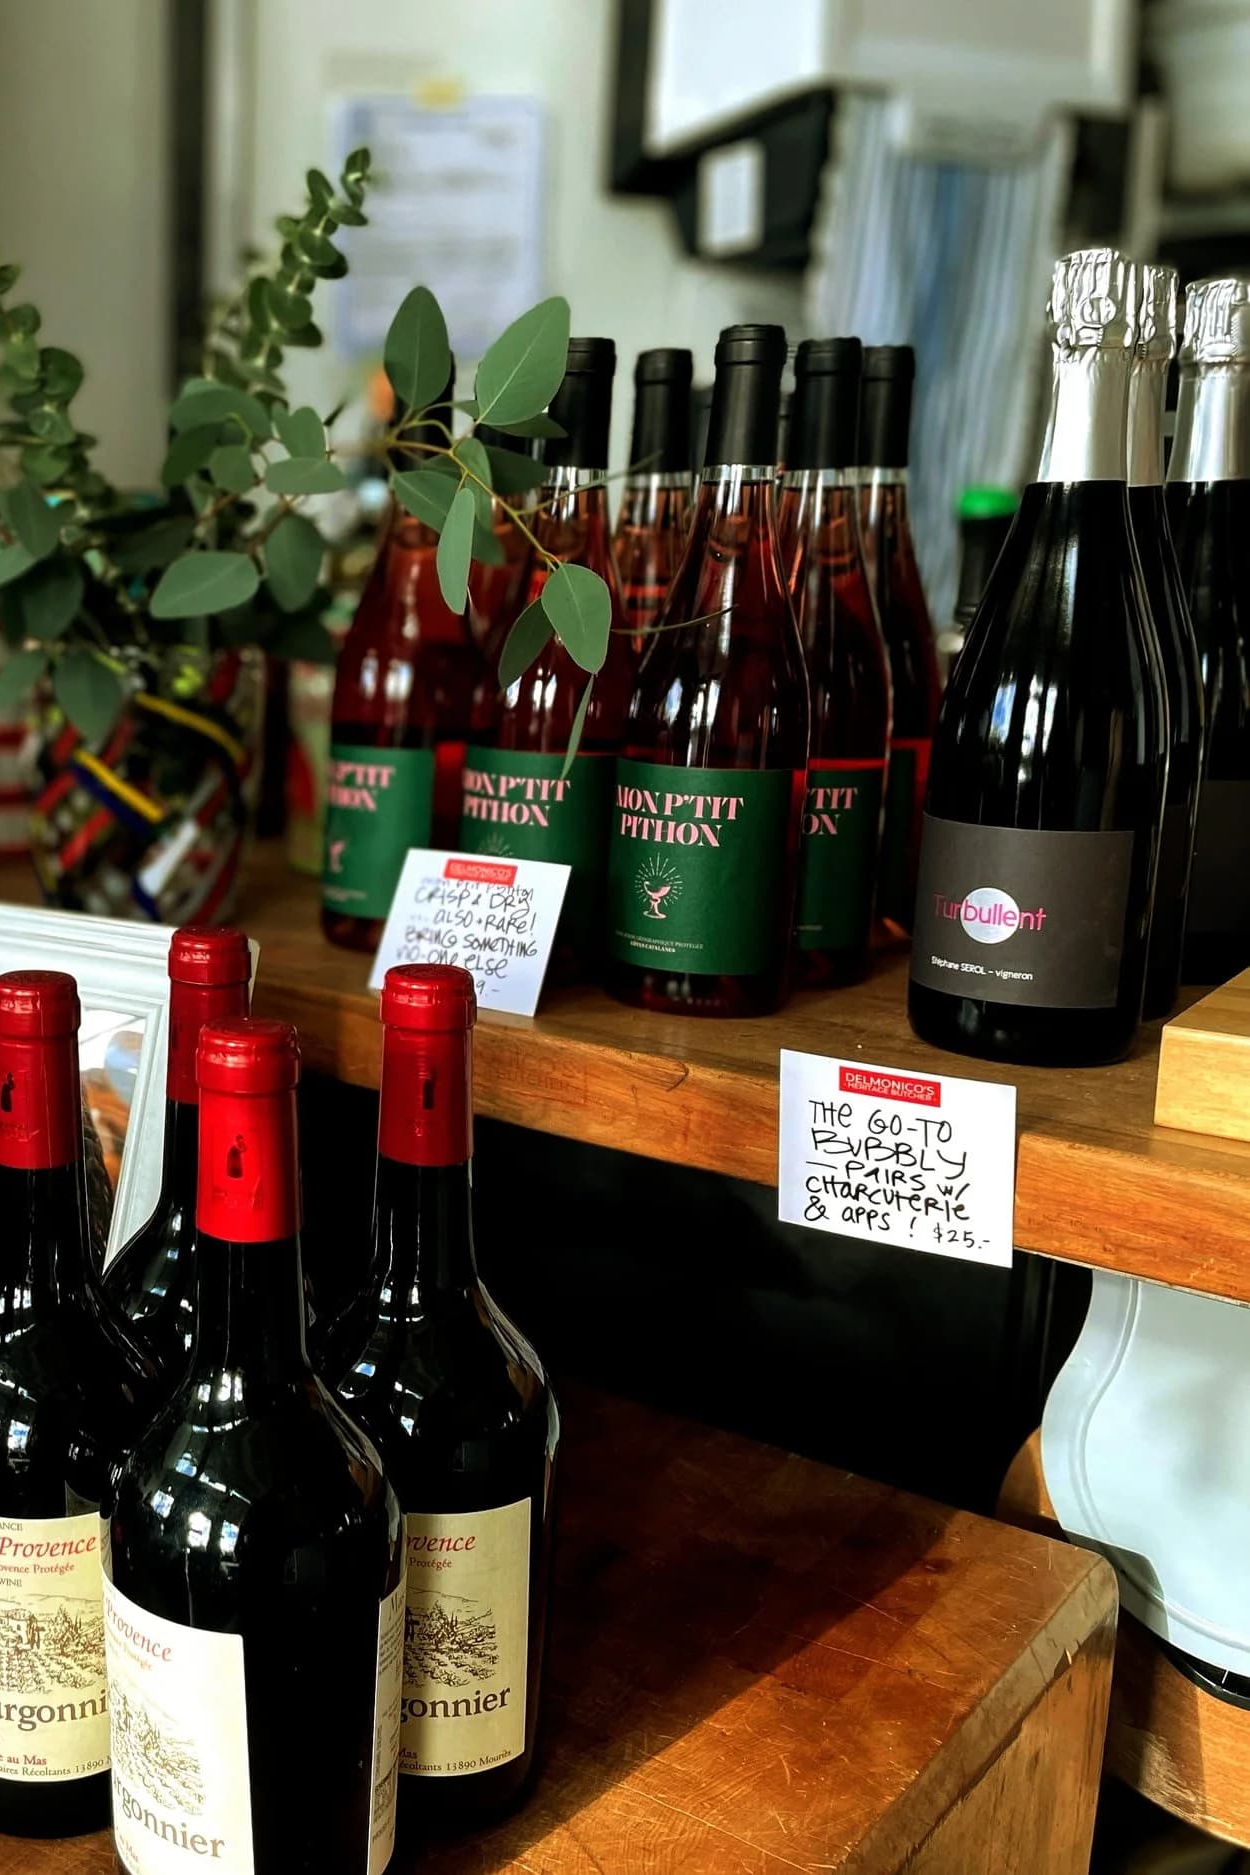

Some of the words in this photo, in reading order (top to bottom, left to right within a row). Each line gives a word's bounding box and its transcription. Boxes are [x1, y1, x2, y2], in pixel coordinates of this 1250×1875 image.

[499, 775, 571, 802] P'TIT
[664, 793, 744, 821] P'TIT
[621, 813, 723, 848] PITHON
[933, 892, 1047, 931] Turbullent
[960, 963, 987, 975] SEROL
[995, 968, 1033, 981] vigneron
[845, 1072, 935, 1096] DELMONICO'S
[868, 1109, 953, 1148] GO-TO
[804, 1195, 830, 1222] &
[407, 1536, 476, 1553] vence
[33, 1562, 76, 1576] Protégée
[6, 1754, 20, 1765] au
[23, 1754, 47, 1766] Mas
[22, 1764, 71, 1777] Récoltants
[75, 1758, 104, 1775] 13890
[399, 1758, 442, 1772] écoltants
[446, 1760, 477, 1773] 13890
